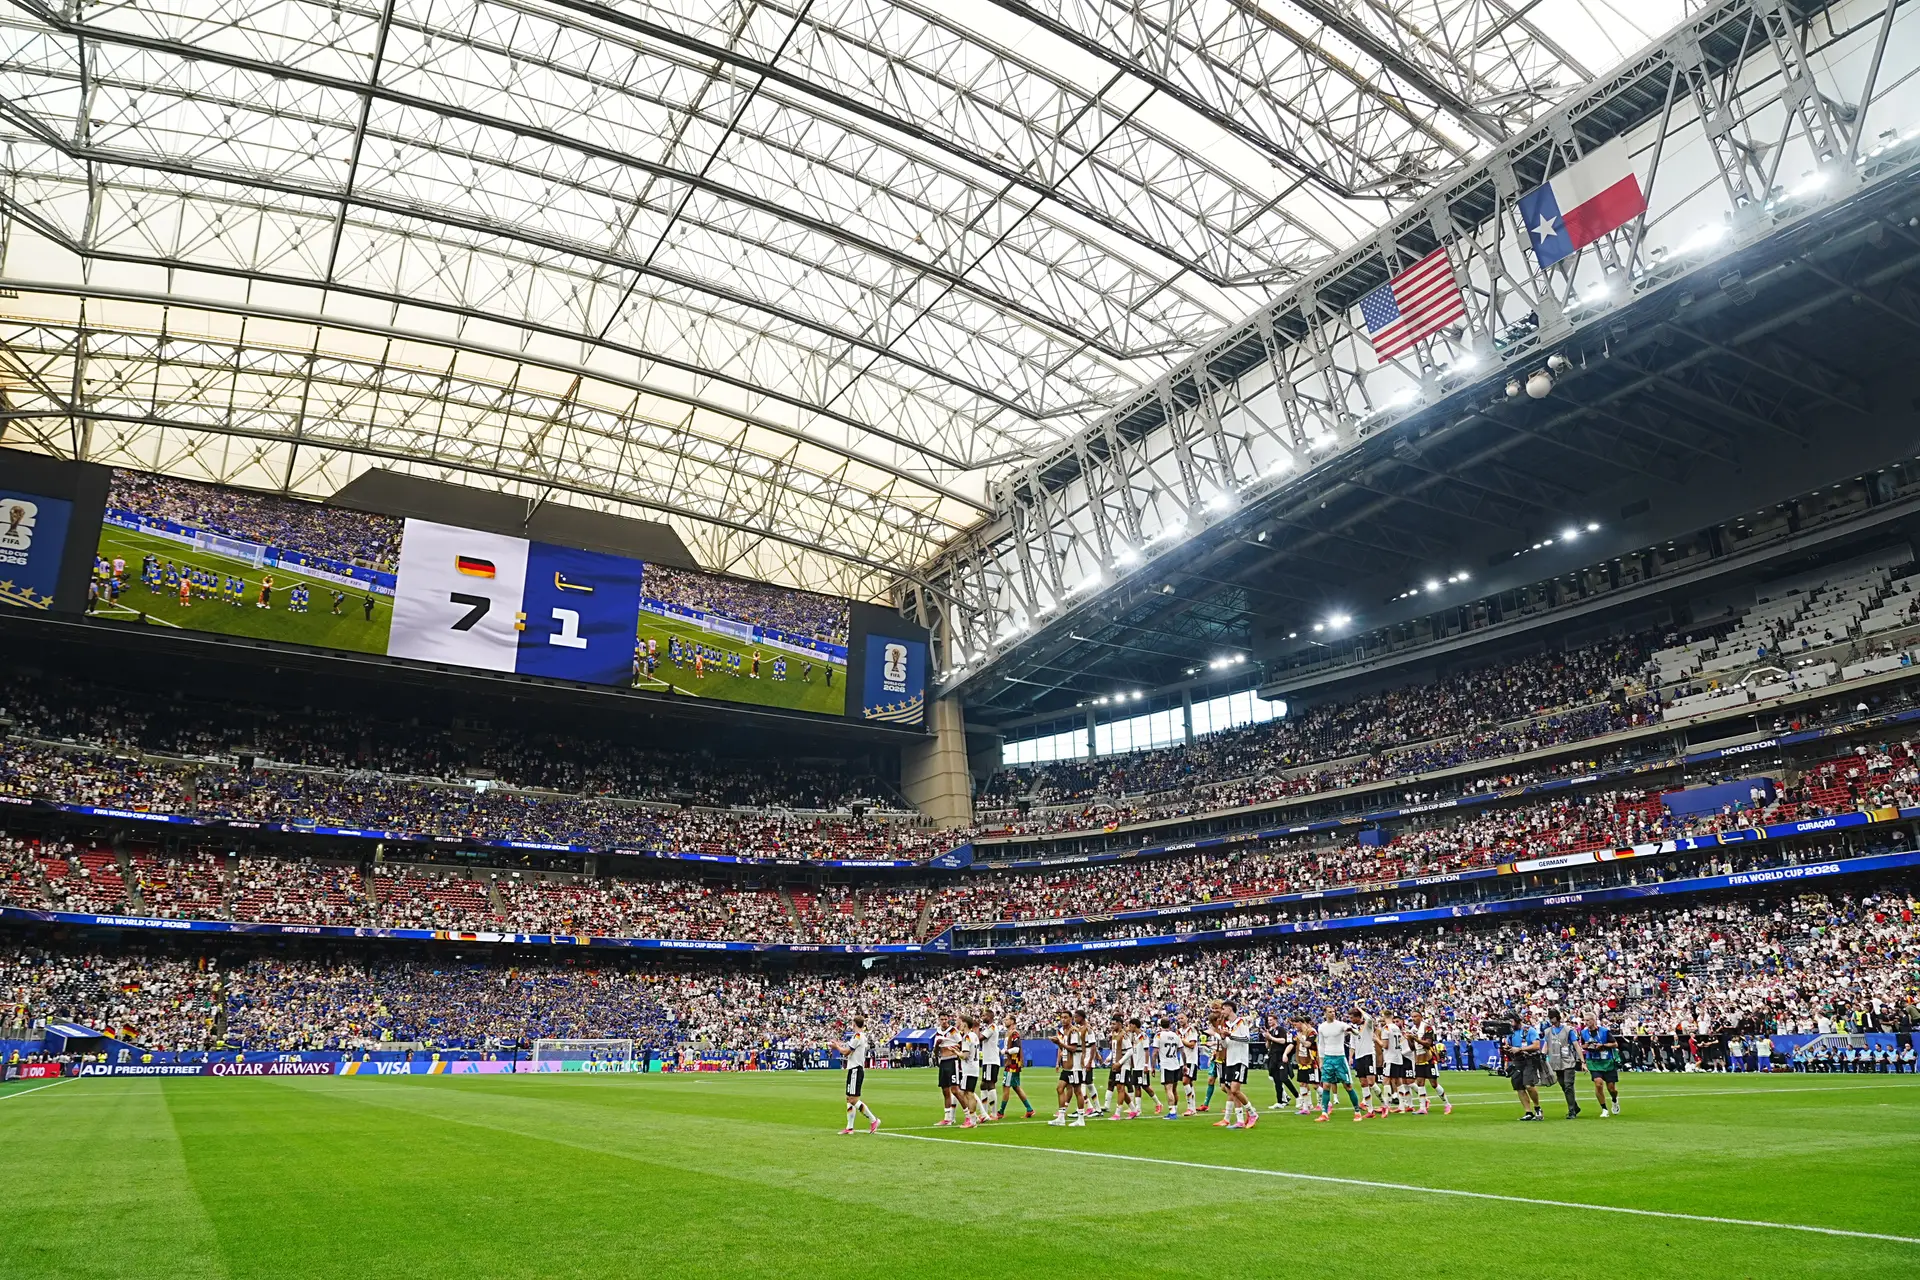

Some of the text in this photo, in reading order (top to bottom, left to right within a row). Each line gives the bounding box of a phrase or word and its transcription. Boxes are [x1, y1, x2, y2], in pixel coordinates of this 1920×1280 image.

[0, 555, 28, 565] 026
[450, 592, 490, 631] 7
[549, 607, 587, 649] 1
[883, 684, 906, 692] 2026
[1720, 739, 1777, 756] HOUSTON
[109, 810, 132, 818] WORLD
[1410, 806, 1428, 814] WORLD
[1164, 843, 1196, 852] HOUSTON
[1538, 819, 1836, 868] GERMANY 7 1 CURAÇAO
[1416, 874, 1460, 885] HOUSTON
[1729, 864, 1840, 884] FIFA WORLD CUP 2026
[1544, 894, 1582, 905] HOUSTON
[1158, 906, 1191, 915] HOUSTON
[114, 918, 144, 926] WORLD
[162, 921, 191, 929] 2026
[498, 934, 531, 943] 7 1
[1164, 1043, 1177, 1058] 22
[81, 1065, 202, 1075] ADI PREDICTSTREET
[212, 1062, 330, 1076] QATAR AIRWAYS
[374, 1062, 411, 1074] VISA
